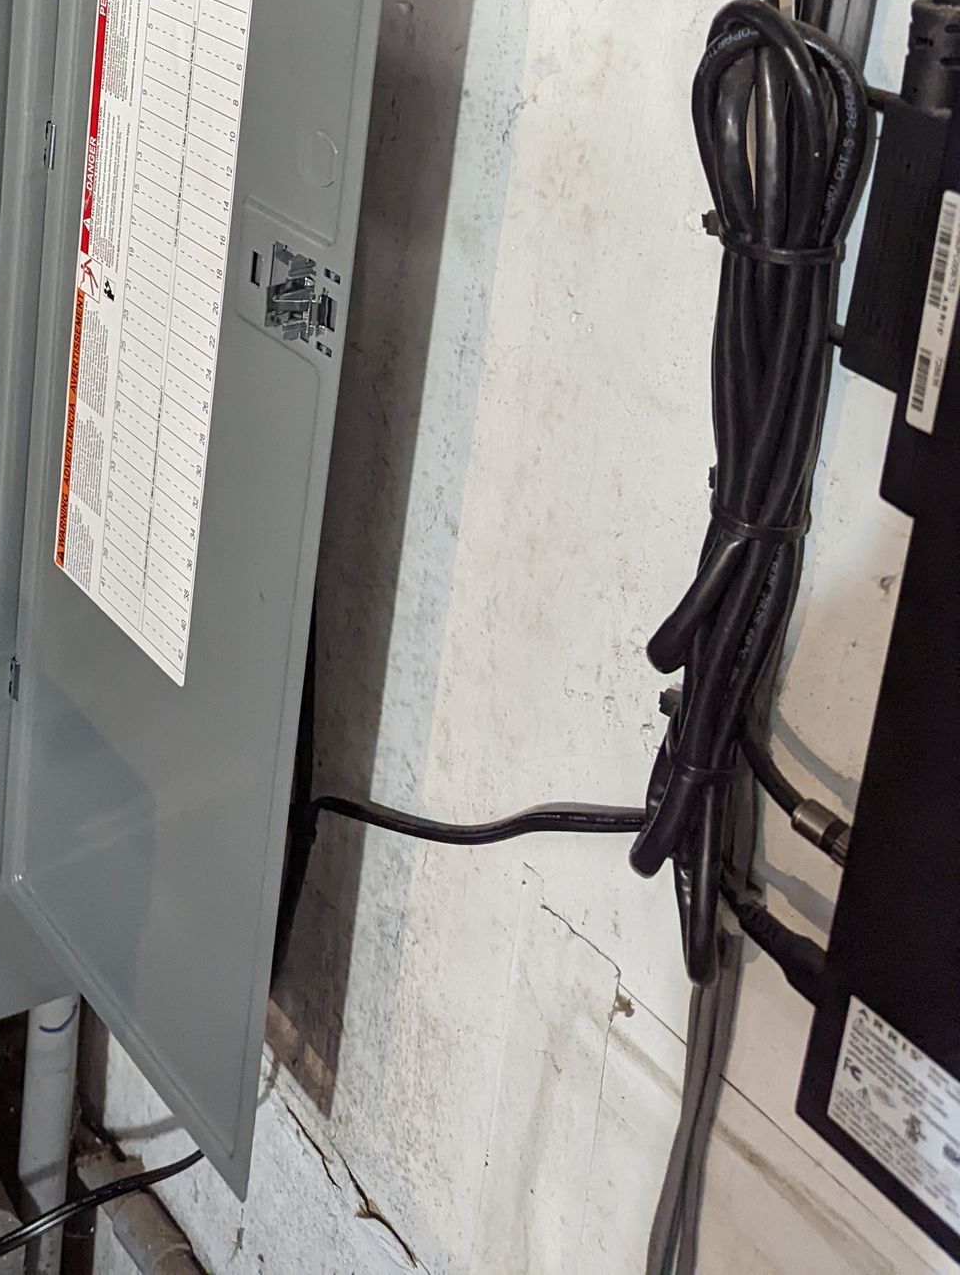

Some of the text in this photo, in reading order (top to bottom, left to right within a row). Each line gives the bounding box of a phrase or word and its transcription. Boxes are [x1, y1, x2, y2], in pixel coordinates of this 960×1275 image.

[240, 27, 246, 35] 4
[233, 99, 239, 107] 8
[229, 131, 235, 143] 10
[86, 136, 97, 191] DANGER
[226, 166, 233, 178] 12
[223, 201, 229, 213] 14
[220, 234, 226, 246] 16
[212, 301, 220, 315] 20
[70, 293, 84, 394] AVERTISSEMENT
[209, 335, 216, 348] 22
[205, 368, 212, 381] 24
[63, 402, 75, 487] ADVERTENCIA
[57, 494, 69, 547] WARNING
